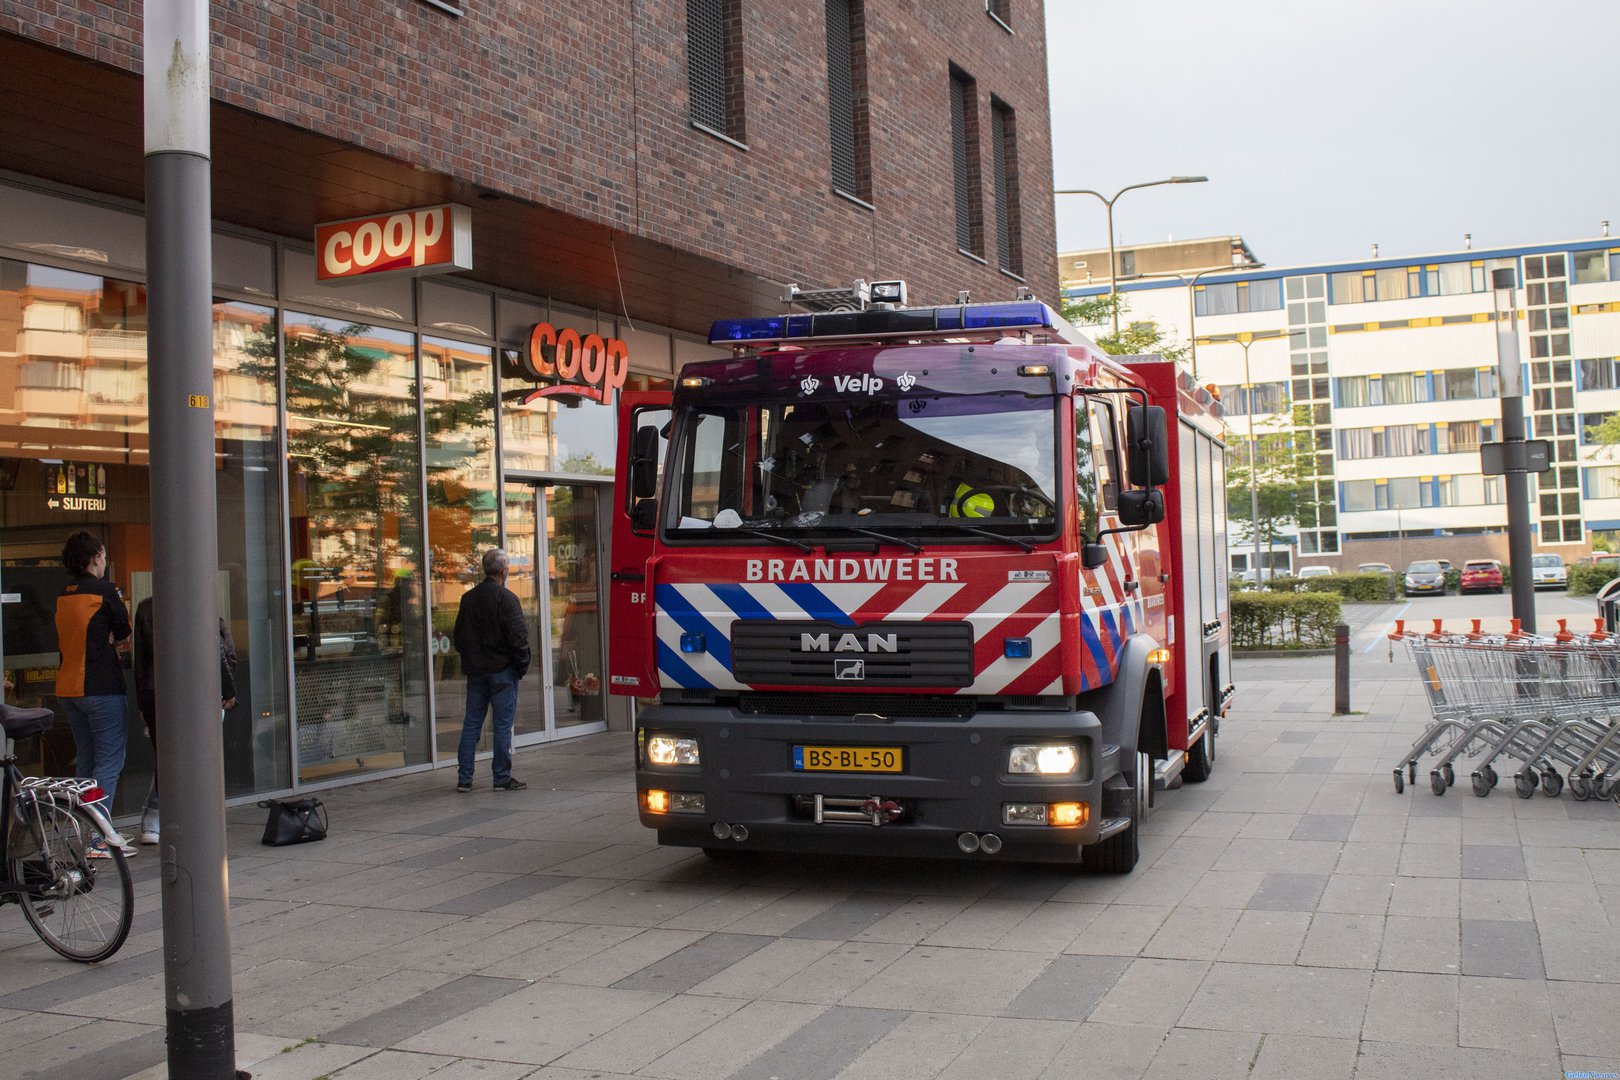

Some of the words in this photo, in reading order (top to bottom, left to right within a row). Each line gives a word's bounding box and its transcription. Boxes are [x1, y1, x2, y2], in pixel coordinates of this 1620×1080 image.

[833, 373, 884, 396] Velp
[746, 558, 960, 582] BRANDWEER
[801, 633, 898, 653] MAN
[809, 750, 895, 768] BS-BL-50
